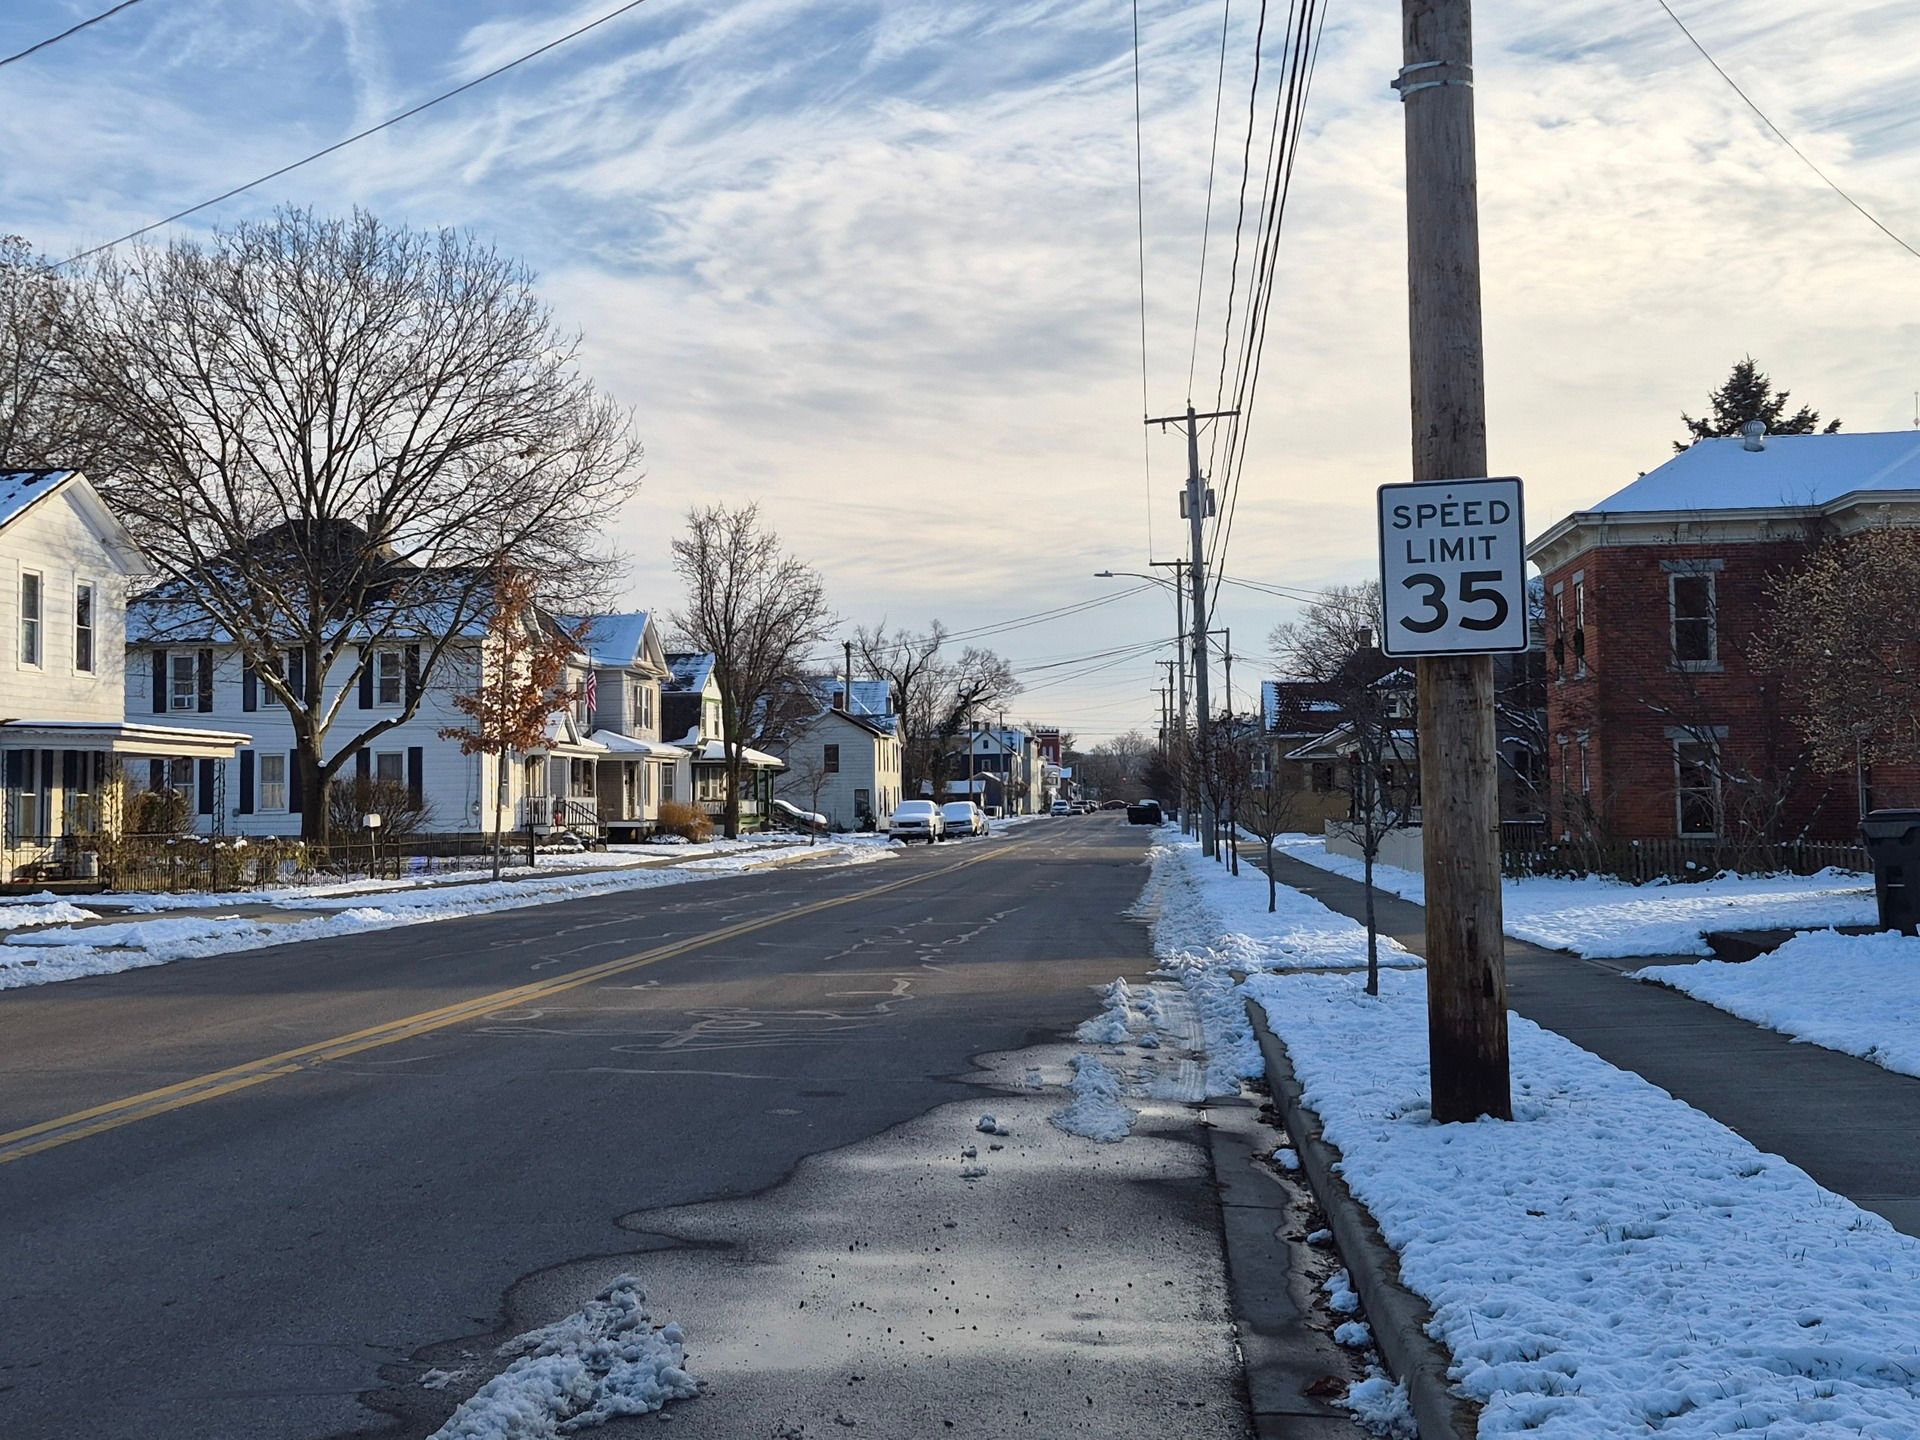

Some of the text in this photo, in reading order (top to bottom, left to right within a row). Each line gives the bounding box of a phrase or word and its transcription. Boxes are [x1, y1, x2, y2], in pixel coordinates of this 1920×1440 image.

[1392, 500, 1510, 529] SPEED
[1406, 536, 1497, 564] LIMIT
[1399, 570, 1509, 634] 35
